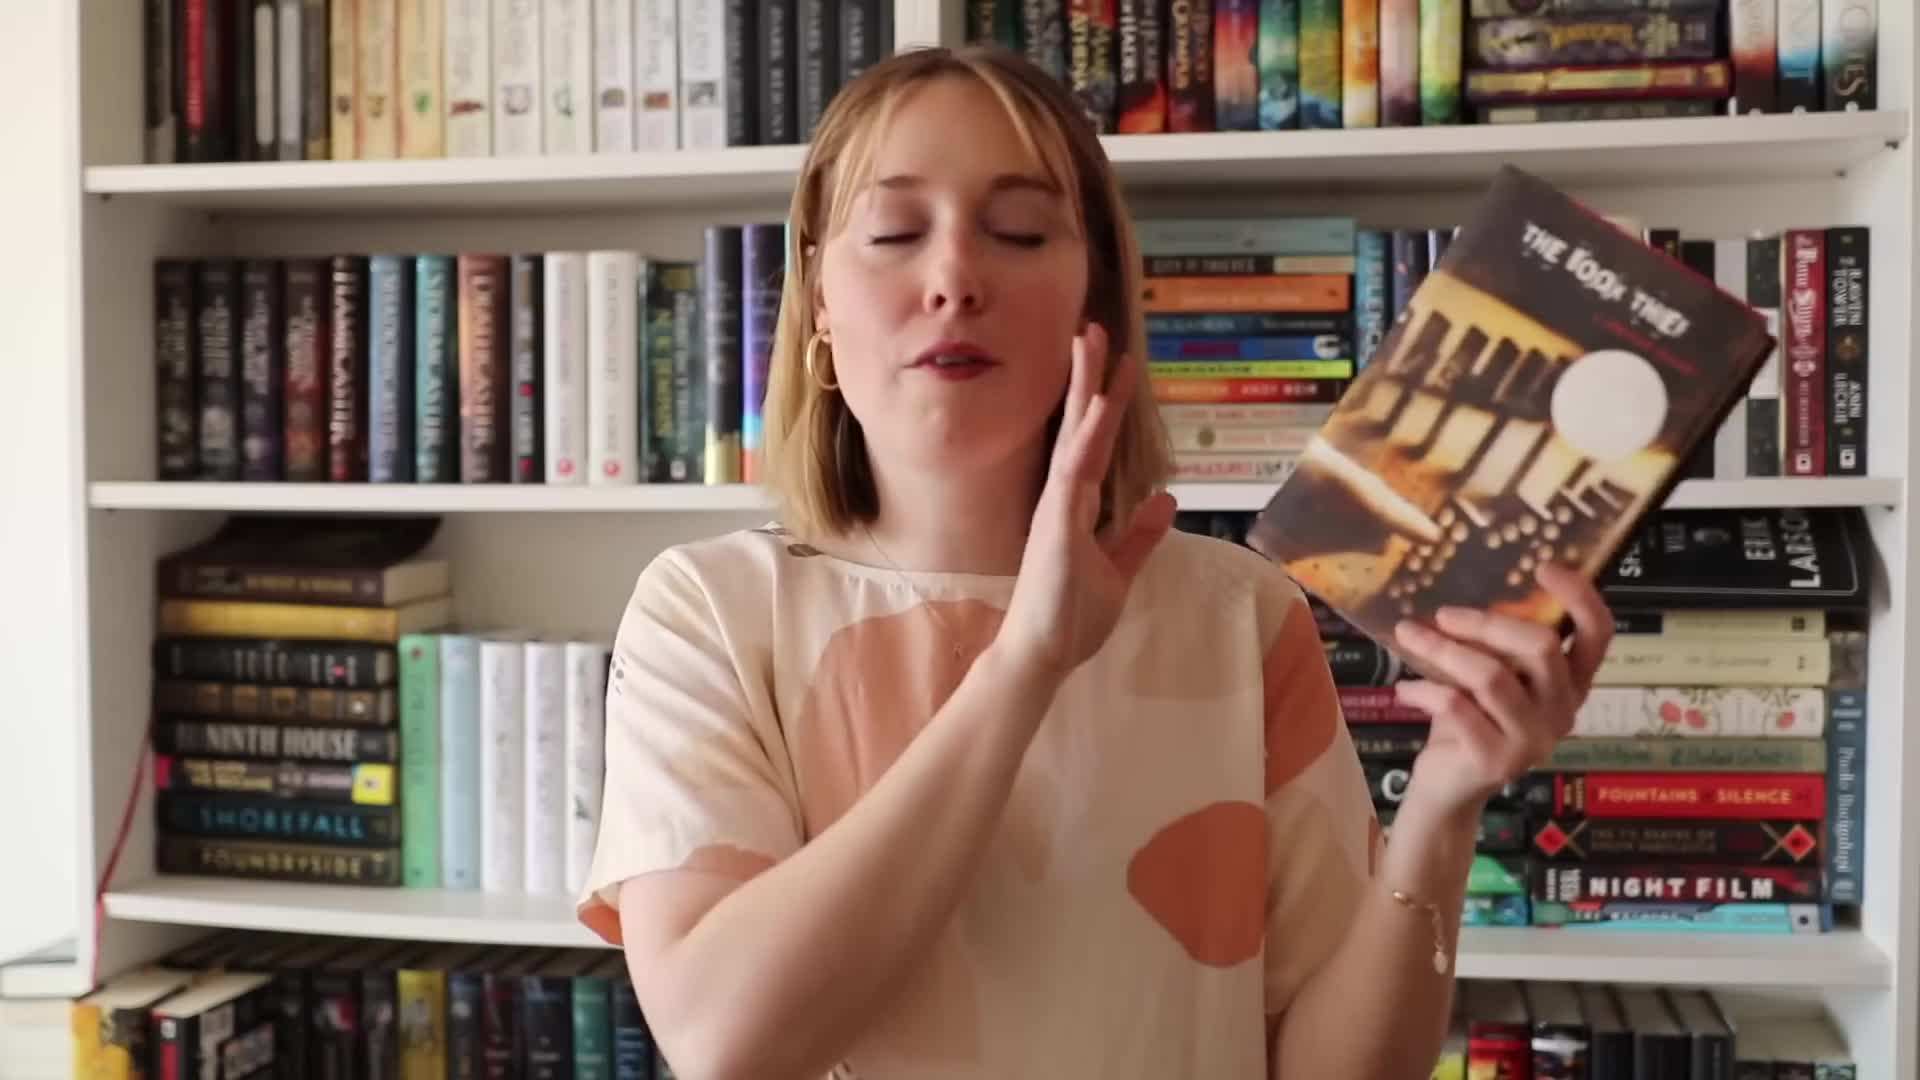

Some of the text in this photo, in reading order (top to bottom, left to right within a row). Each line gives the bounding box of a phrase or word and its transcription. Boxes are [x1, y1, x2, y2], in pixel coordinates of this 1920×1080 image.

[1521, 220, 1569, 265] THE
[1833, 269, 1848, 327] TOWER
[1848, 268, 1862, 326] RAVEN
[205, 725, 356, 759] NINTH HOUSE
[1598, 787, 1698, 804] FOUNTAINS
[1716, 787, 1794, 805] SILENCE
[1589, 876, 1687, 899] NIGHT
[1696, 877, 1775, 900] FILM
